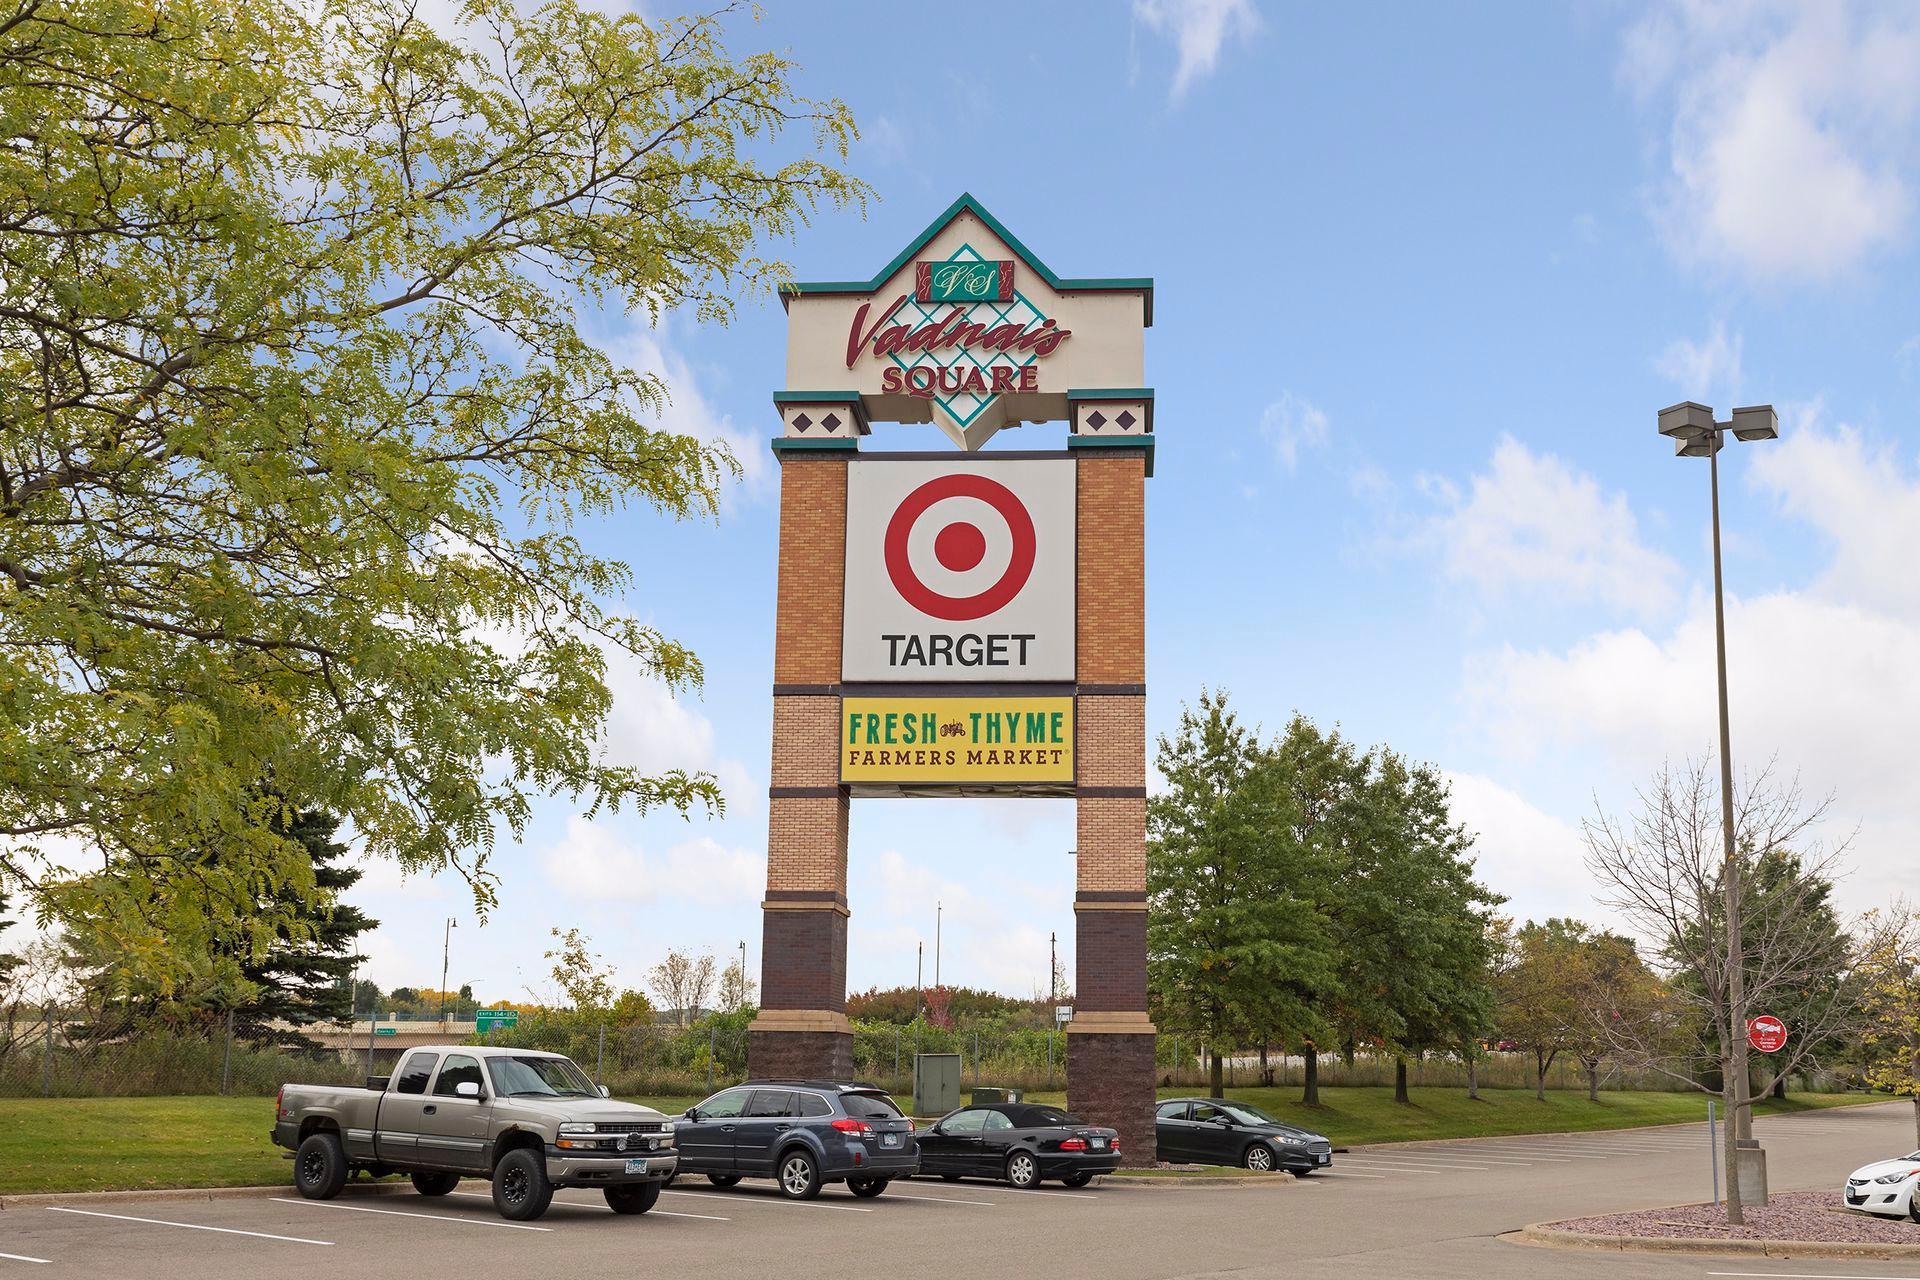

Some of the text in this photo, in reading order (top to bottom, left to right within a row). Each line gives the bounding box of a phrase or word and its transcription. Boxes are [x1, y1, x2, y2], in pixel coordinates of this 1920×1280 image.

[846, 294, 1072, 370] Vadnais
[881, 365, 1040, 399] SQUARE
[881, 633, 1036, 667] TARGET
[849, 711, 1064, 745] FRESH THYME
[849, 749, 1063, 766] FARMERS MARKET
